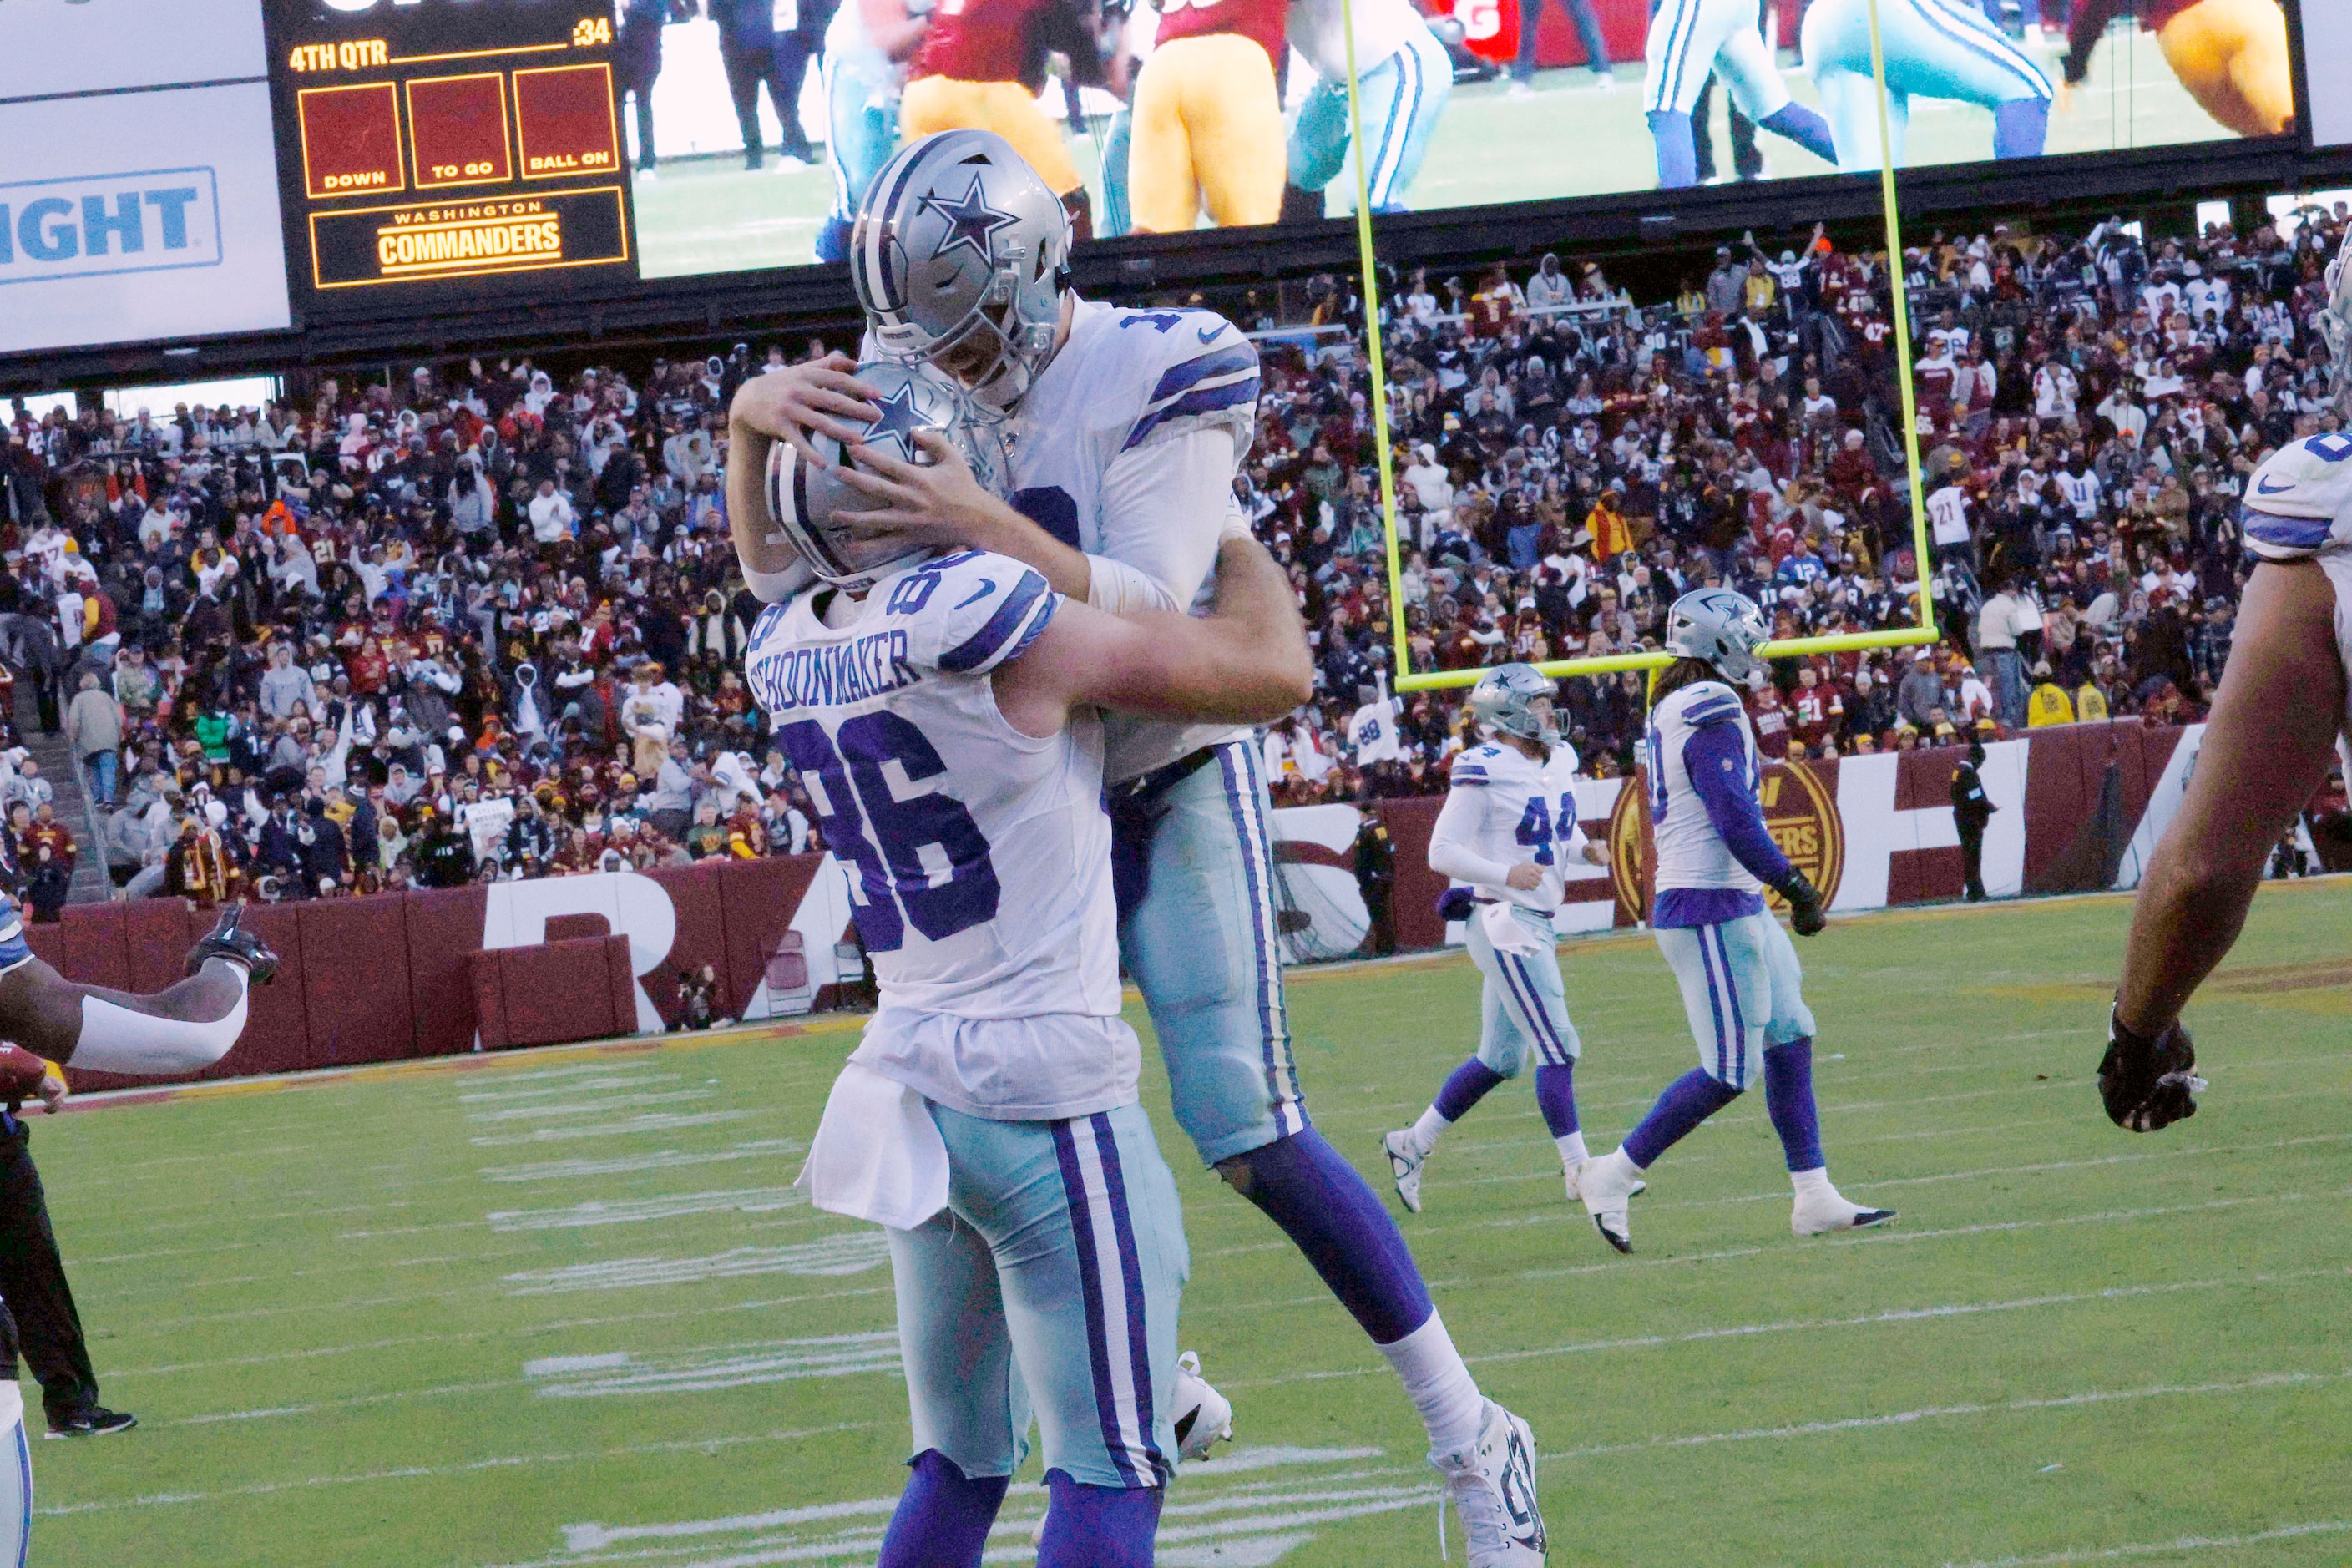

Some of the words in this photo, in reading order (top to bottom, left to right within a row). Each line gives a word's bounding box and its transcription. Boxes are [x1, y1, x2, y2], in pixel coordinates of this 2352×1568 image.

[289, 43, 335, 72] 4TH
[340, 39, 388, 68] QTR
[573, 18, 611, 48] :34
[432, 164, 458, 179] TO
[465, 161, 493, 177] GO
[530, 154, 578, 171] BALL
[582, 150, 609, 166] ON
[324, 171, 386, 190] DOWN
[394, 200, 543, 225] WASHINGTON
[377, 221, 561, 266] COMMANDERS
[777, 709, 1001, 953] 86
[1515, 791, 1577, 867] 44
